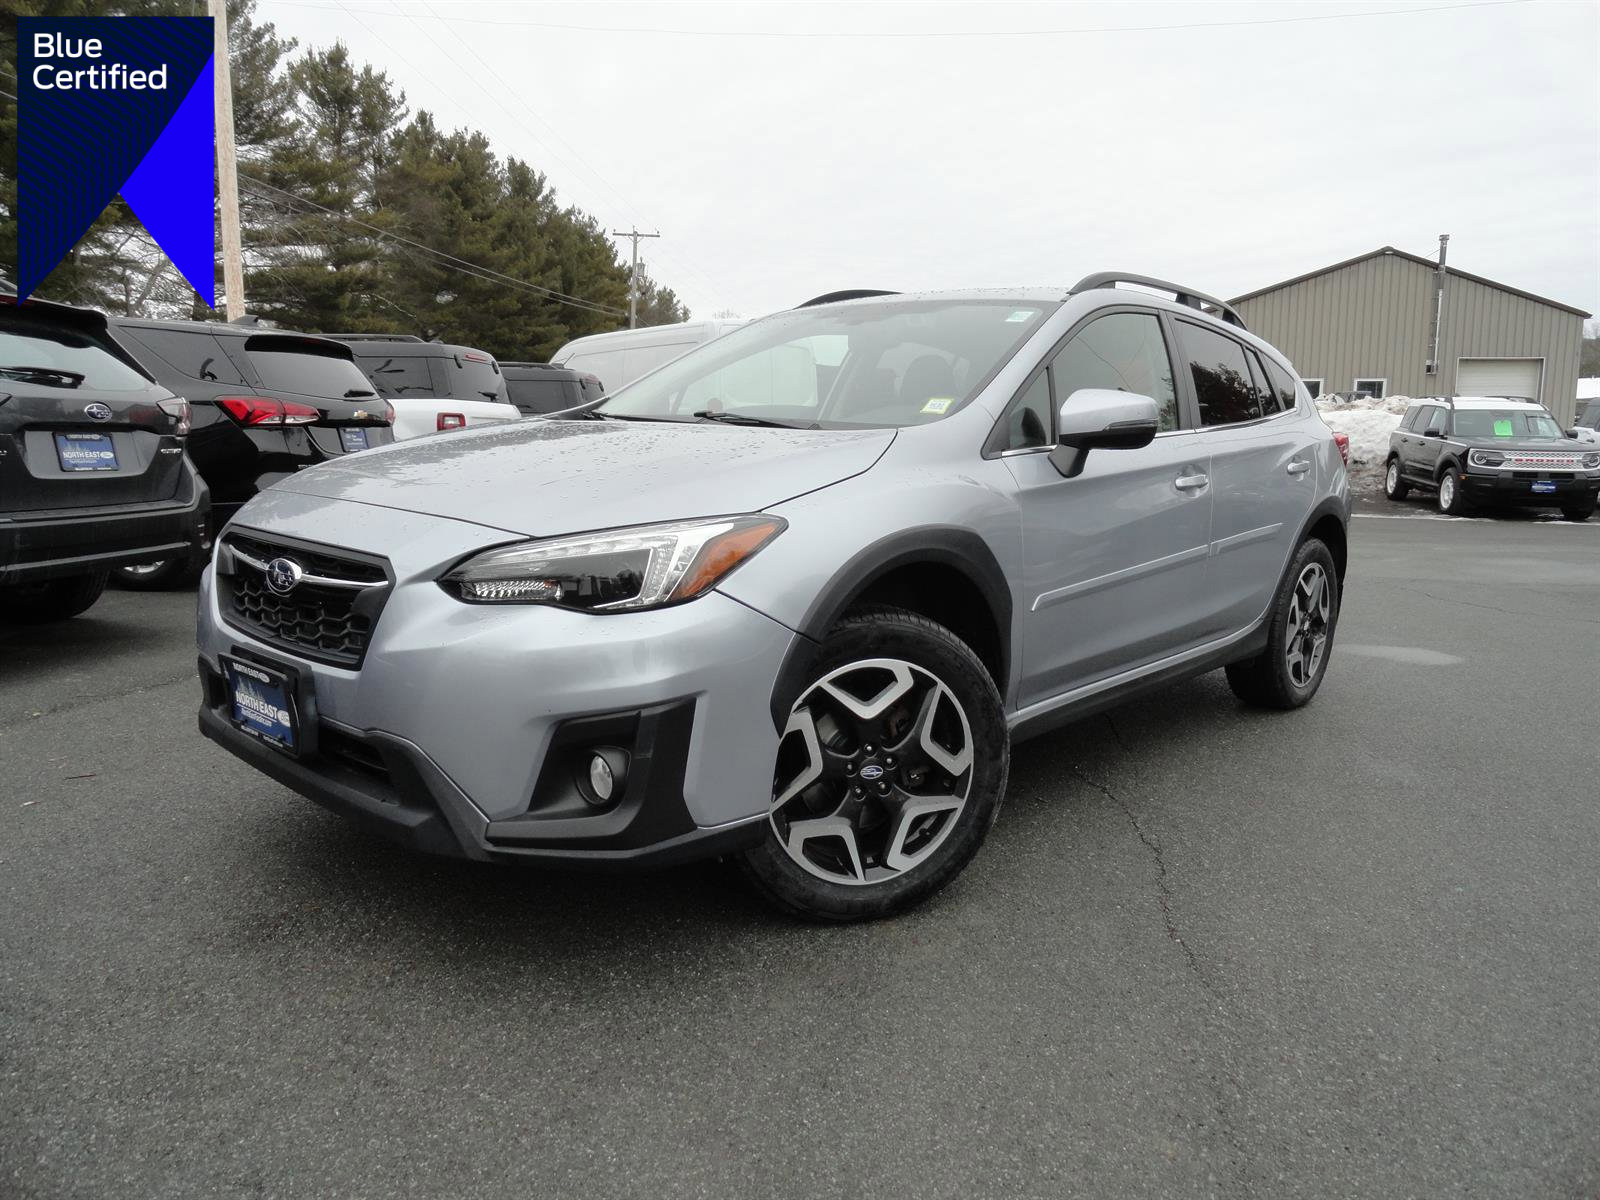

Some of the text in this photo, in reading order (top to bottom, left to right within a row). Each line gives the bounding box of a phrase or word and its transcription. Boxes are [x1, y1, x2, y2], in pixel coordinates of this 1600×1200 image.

[63, 451, 84, 459] NORTH
[235, 690, 259, 711] NORTH
[259, 701, 278, 719] EAST
